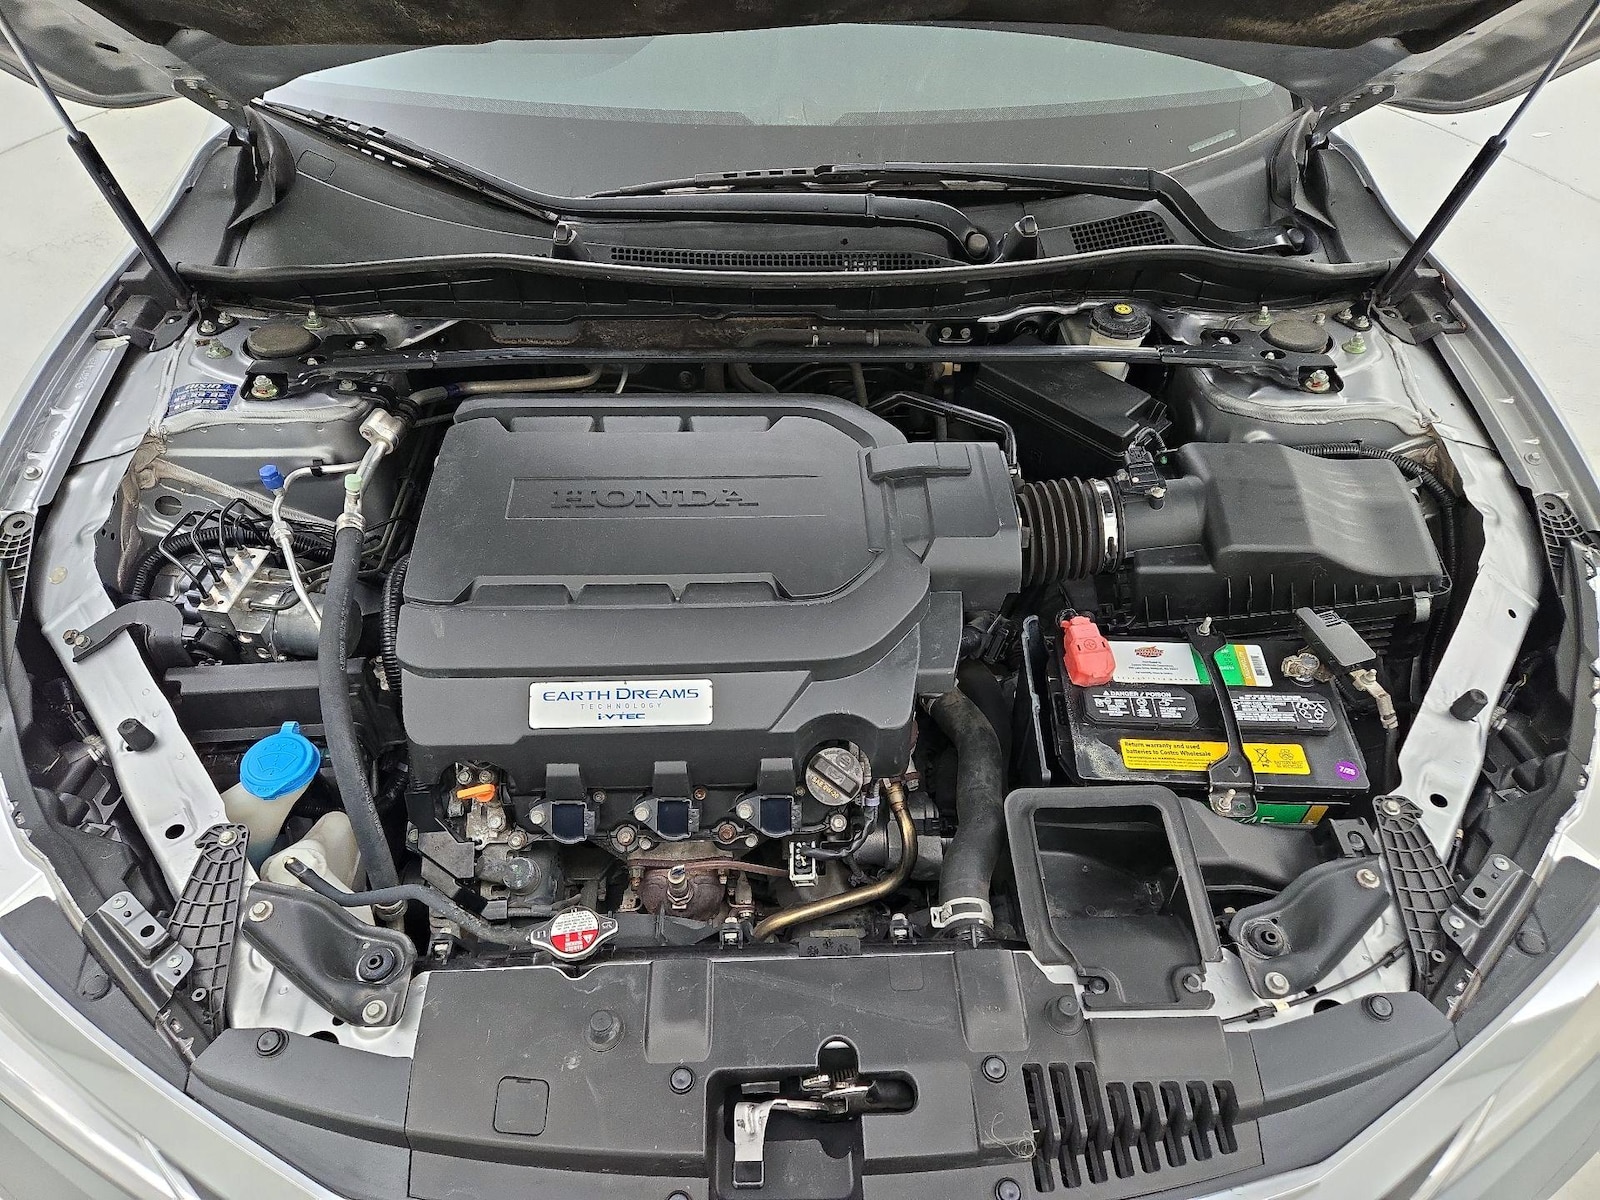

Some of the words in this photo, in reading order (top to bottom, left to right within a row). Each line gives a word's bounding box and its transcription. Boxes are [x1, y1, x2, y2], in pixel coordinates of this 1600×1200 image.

[550, 489, 760, 509] HONDA
[543, 690, 611, 701] EARTH
[616, 688, 699, 700] DREAMS
